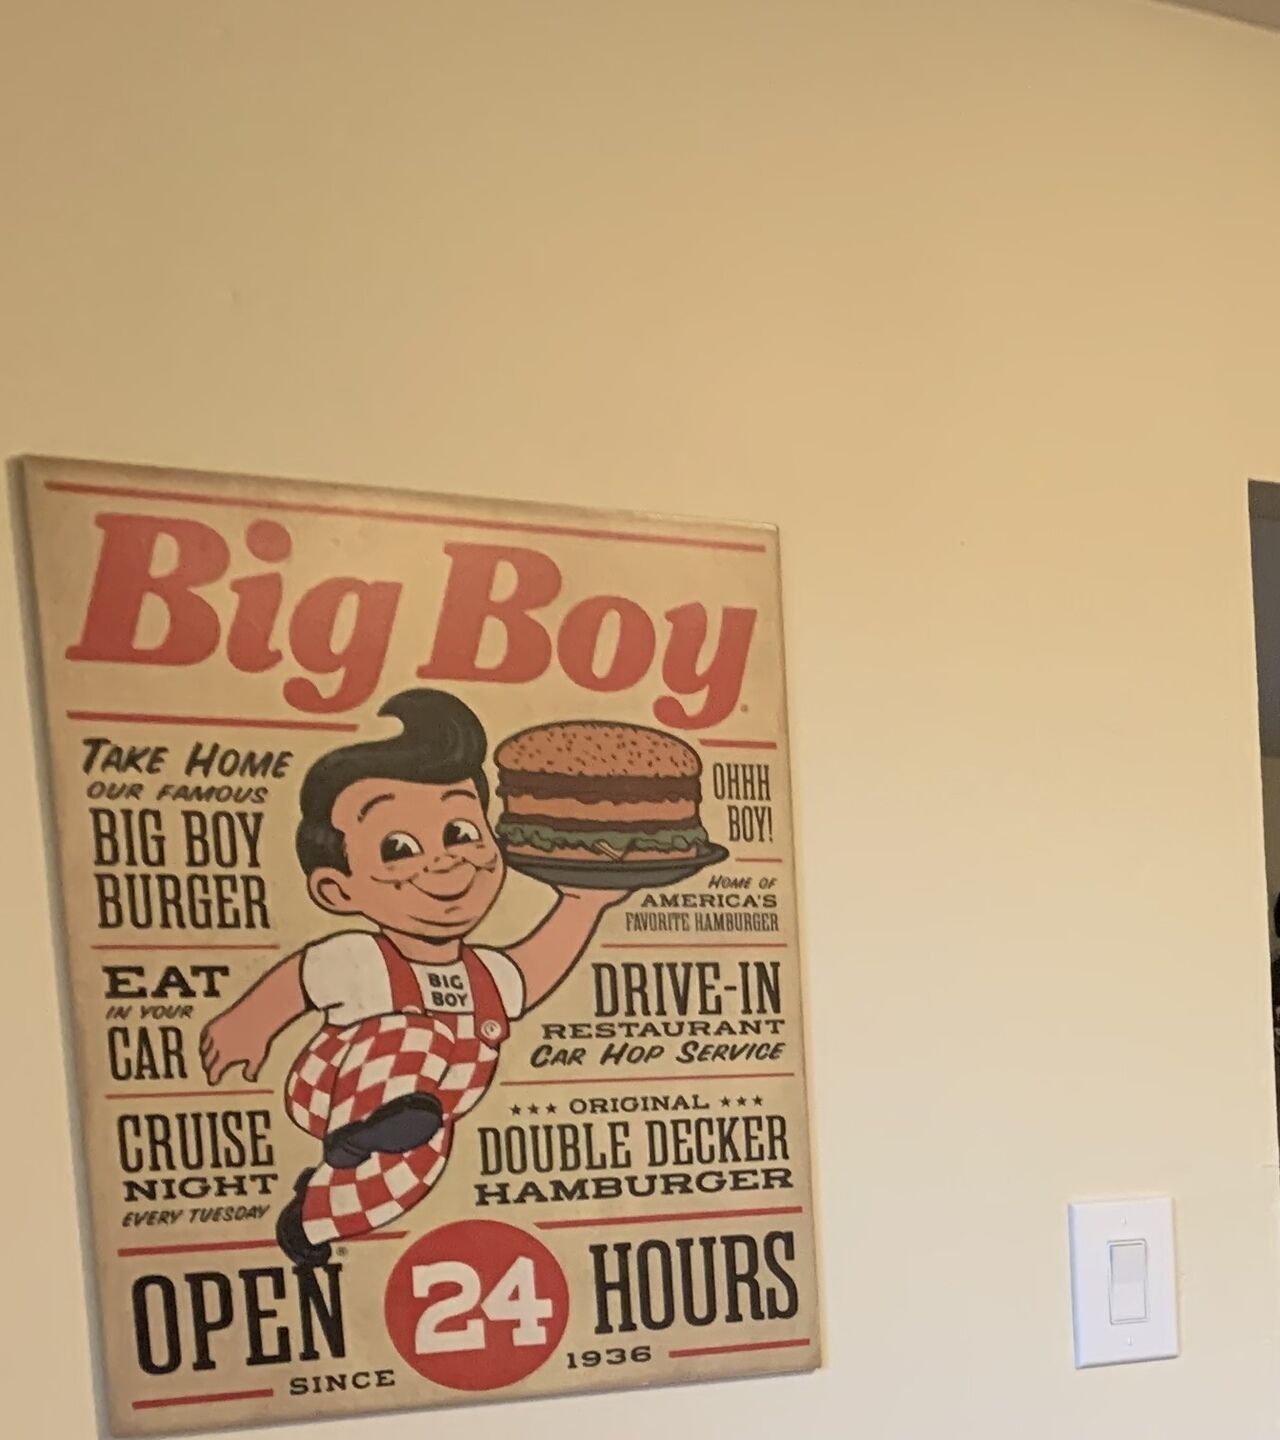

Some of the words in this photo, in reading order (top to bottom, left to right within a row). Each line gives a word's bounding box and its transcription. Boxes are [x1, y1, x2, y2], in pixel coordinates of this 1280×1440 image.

[65, 511, 403, 714] Big
[416, 542, 758, 730] Boy
[82, 737, 169, 775] TAKE
[184, 741, 294, 779] HOME
[86, 780, 144, 800] OUR
[156, 783, 268, 804] FAMOUS
[713, 763, 771, 801] OHHH
[89, 807, 166, 867] BIG
[181, 809, 264, 868] BOY
[727, 805, 774, 844] BOY!
[94, 872, 271, 929] BURGER
[640, 893, 778, 908] AMERICA'S
[708, 874, 752, 890] HOME
[759, 877, 778, 891] OF
[625, 911, 689, 932] FAVORITE
[694, 912, 780, 932] HAMBURGER
[102, 965, 229, 999] EAT
[427, 972, 464, 990] BIG
[431, 991, 468, 1007] BOY
[591, 961, 781, 1018] DRIVE-IN
[106, 1004, 132, 1020] IN
[141, 1005, 194, 1020] YOUR
[541, 1018, 786, 1040] RESTAURANT
[108, 1026, 189, 1081] CAR
[530, 1043, 586, 1069] CAR
[600, 1042, 665, 1066] HOP
[675, 1040, 786, 1064] SERVICE
[569, 1094, 710, 1115] ORIGINAL
[117, 1109, 275, 1174] CRUISE
[477, 1121, 631, 1176] DOUBLE
[645, 1114, 790, 1168] DECKER
[122, 1173, 279, 1202] NIGHT
[474, 1167, 794, 1207] HAMBURGER
[122, 1209, 183, 1228] EVERY
[189, 1204, 270, 1224] TUESDAY
[131, 1262, 346, 1376] OPEN
[411, 1255, 554, 1356] 24
[588, 1230, 800, 1336] HOURS
[289, 1369, 396, 1396] SINCE
[566, 1345, 653, 1369] 1936
